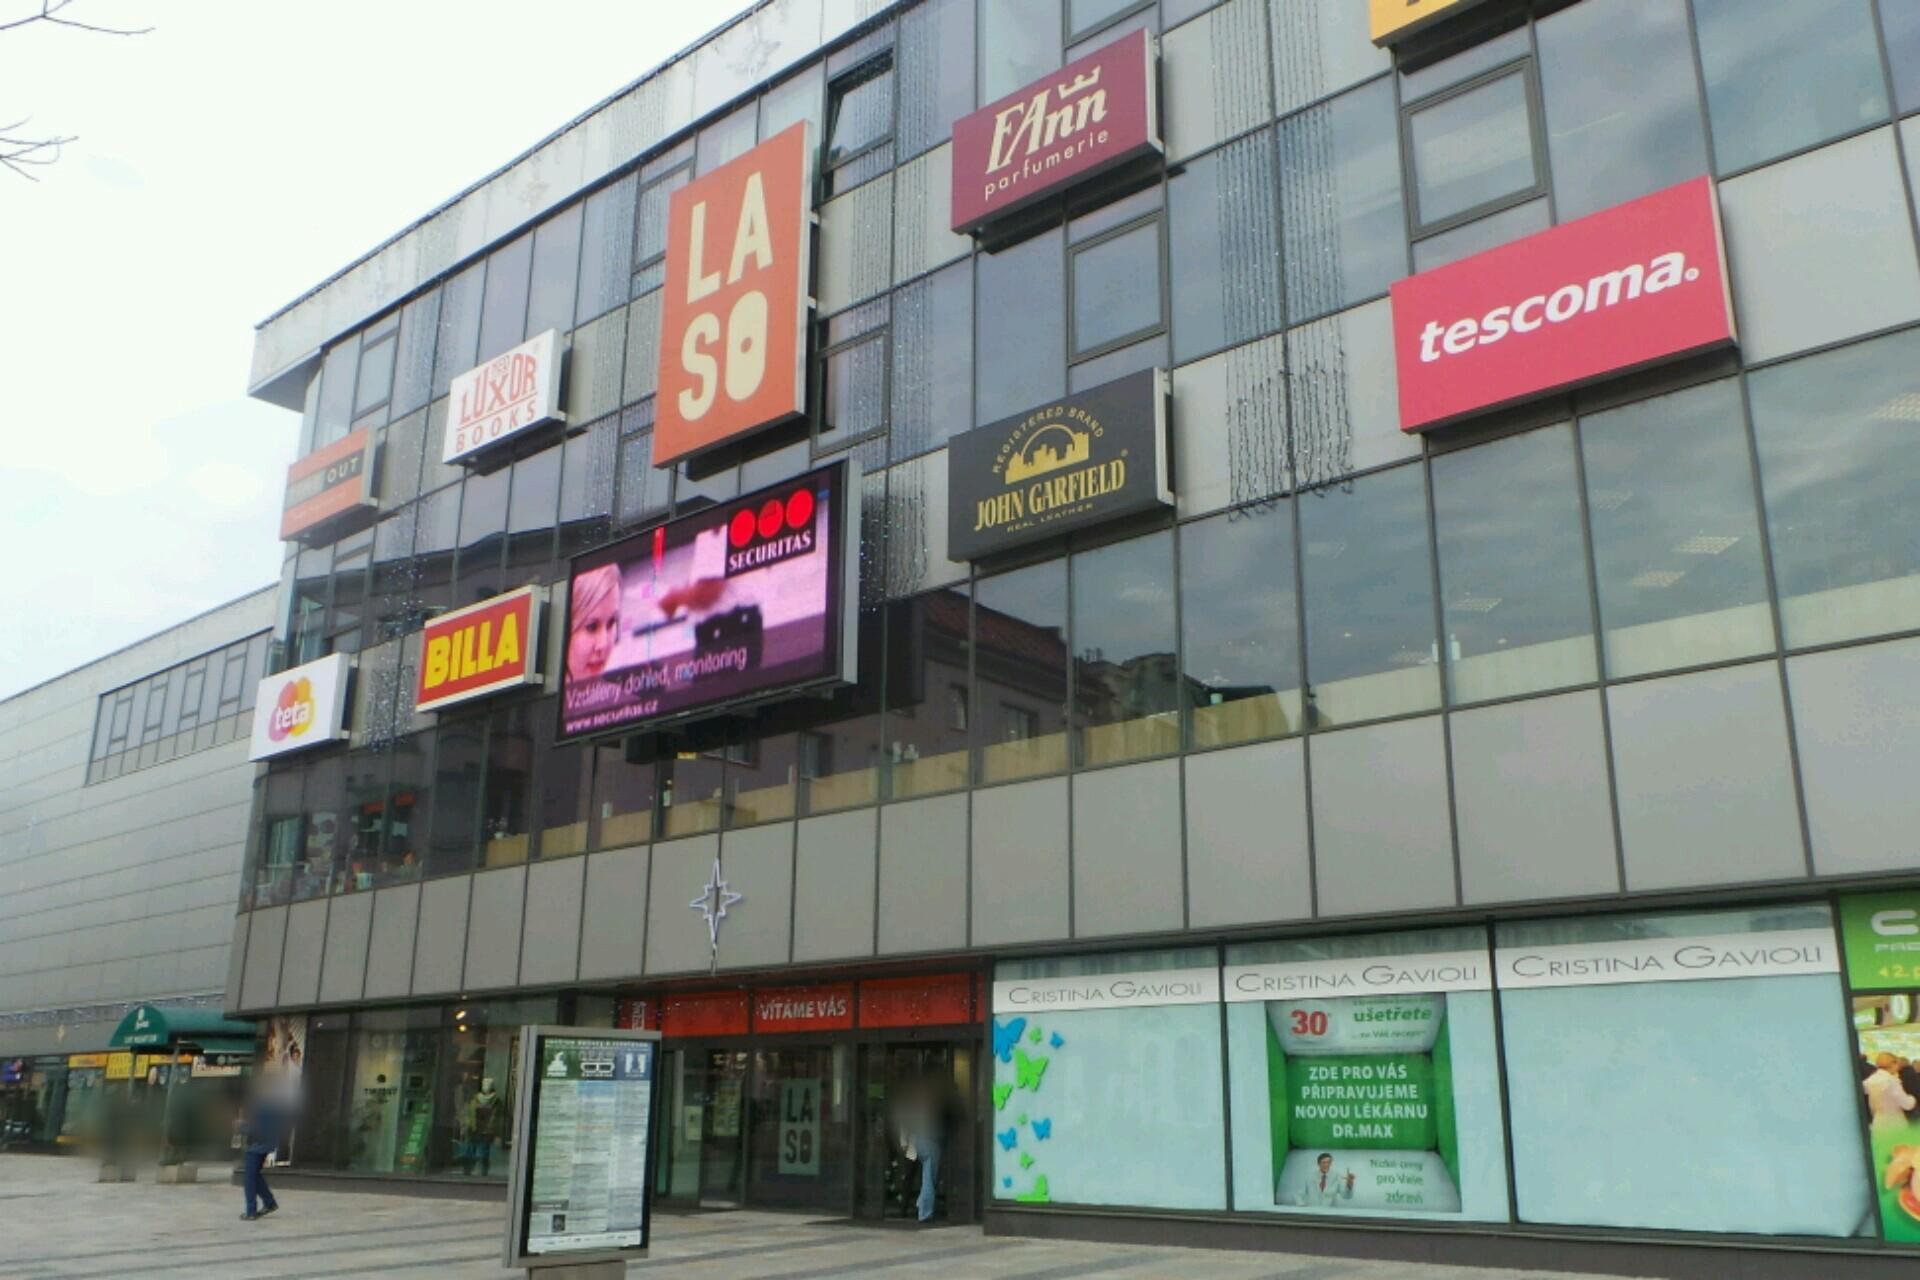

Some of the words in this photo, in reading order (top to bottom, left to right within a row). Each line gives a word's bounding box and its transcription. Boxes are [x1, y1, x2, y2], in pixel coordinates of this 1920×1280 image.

[985, 88, 1108, 175] FAnn
[984, 130, 1109, 201] parfumerie
[687, 171, 773, 304] LA
[678, 290, 768, 422] SO
[460, 352, 537, 424] LUXOR
[455, 400, 537, 453] BOOKS
[1068, 407, 1104, 438] BRAND
[327, 456, 359, 483] OUT
[974, 488, 1025, 532] JOHN
[1028, 458, 1127, 515] GARFIELD
[1006, 520, 1036, 533] REAL
[729, 530, 812, 572] SECURITAS
[423, 612, 520, 690] BILLA
[674, 647, 748, 682] monitoring
[274, 698, 310, 731] teta
[817, 994, 847, 1017] VÁS
[1353, 1007, 1432, 1023] ušetřete
[1309, 1066, 1338, 1081] ZDE
[1342, 1065, 1373, 1080] PRO
[1376, 1061, 1407, 1079] VÁS
[786, 1087, 814, 1123] LA
[1301, 1083, 1419, 1100] PŘIPRAVUJEME
[1295, 1105, 1350, 1119] NOVOU
[1354, 1102, 1428, 1119] LÉKÁRNU
[785, 1129, 813, 1165] SO
[1332, 1123, 1393, 1138] DR.MAX
[1376, 1174, 1396, 1186] pro
